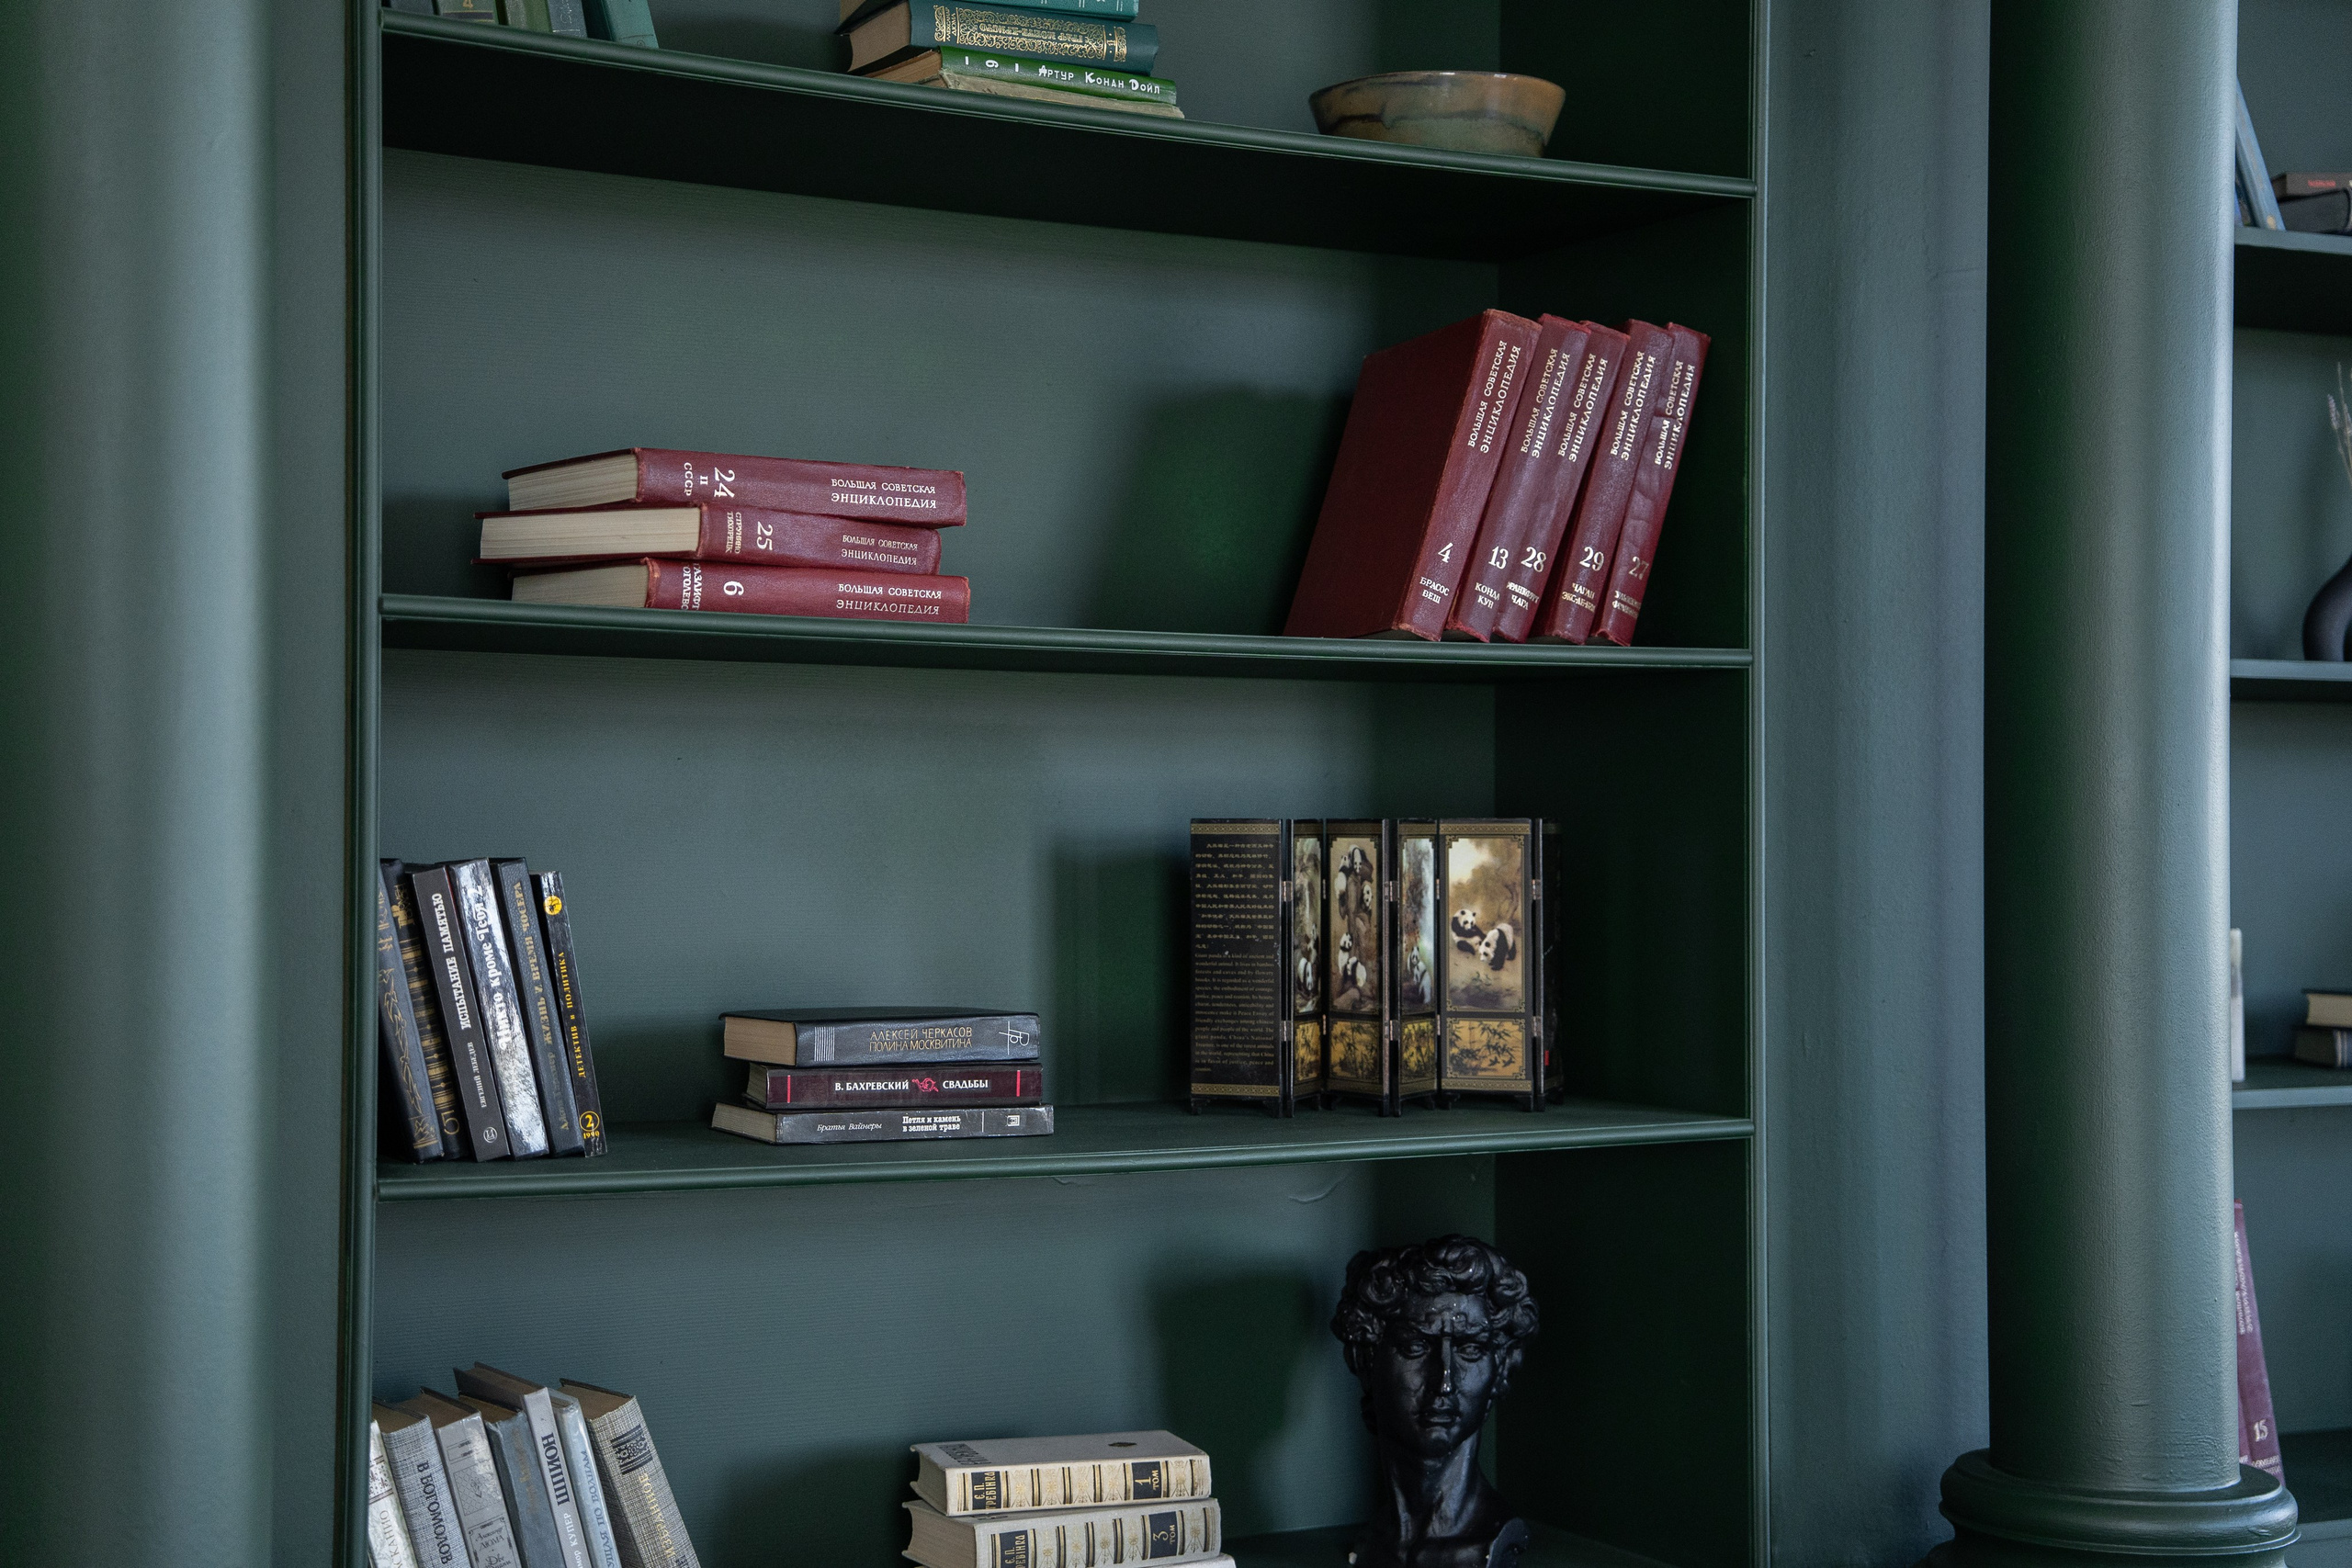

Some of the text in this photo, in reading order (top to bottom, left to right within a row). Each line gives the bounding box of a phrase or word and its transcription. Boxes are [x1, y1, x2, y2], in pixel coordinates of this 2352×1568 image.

[1467, 339, 1508, 448] БОЛЬШАЯ СОВЕТСКАЯ
[1479, 344, 1522, 455] ЭНЦИКЛОПЕДИЯ
[1665, 359, 1684, 416] СОВЕТСКАЯ
[1521, 348, 1558, 454] БОЛЬШАЯ СОВЕТСКАЯ
[1532, 352, 1570, 458] ЭНЦИКЛОПЕДИЯ
[1558, 353, 1597, 457] БОЛЬШАЯ СОВЕТСКАЯ
[1568, 357, 1609, 463] ЭНЦИКЛОПЕДИЯ
[1610, 351, 1645, 457] БОЛЬШАЯ СОВЕТСКАЯ
[1621, 355, 1657, 461] ЭНЦИКЛОПЕДИЯ
[683, 462, 693, 497] СССР
[713, 466, 736, 499] 24
[831, 477, 936, 494] БОЛЬШАЯ СОВЕТСКАЯ
[831, 492, 937, 510] ЭНЦИКЛОПЕДИЯ
[756, 522, 774, 551] 25
[842, 534, 919, 552] БОЛЬШАЯ СОВЕТСКАЯ
[841, 547, 918, 567] ЭНЦИКЛОПЕДИЯ
[1438, 542, 1453, 563] 4
[1488, 546, 1510, 570] 13
[1521, 547, 1547, 573] 28
[1578, 546, 1605, 571] 29
[1628, 556, 1650, 581] 27
[723, 580, 745, 596] 6
[837, 582, 943, 601] БОЛЬШАЯ СОВЕТСКАЯ
[1419, 576, 1450, 596] БРАСОС
[1422, 589, 1442, 604] ВЕШ
[835, 598, 941, 616] ЭНЦИКЛОПЕДИЯ
[1477, 594, 1495, 609] КУН
[1511, 593, 1529, 610] ЧАГА
[513, 881, 530, 931] ЧОСЕРА
[431, 892, 472, 1030] ИСПЫТАНИЕ ПАМЯТЬЮ
[482, 942, 503, 988] кроме
[526, 935, 545, 984] ВРЕМЯ
[559, 952, 574, 1009] ПОЛИТИКА
[869, 1026, 973, 1042] АЛЕКСЕЙ ЧЕРКАСОВ
[869, 1038, 973, 1053] ПОЛИНА МОСКВИТИНА
[571, 1025, 587, 1078] ДЕТЕКТИВ
[834, 1078, 989, 1091] В. БАХРЕВСКИЙ СВАДЬБЫ
[441, 1110, 459, 1134] 5
[817, 1123, 846, 1134] Братья
[902, 1115, 926, 1124] Петля
[2254, 1418, 2269, 1442] 15
[541, 1433, 571, 1506] ШПИОН
[1134, 1477, 1151, 1485] 1
[420, 1472, 452, 1565] БОГОМОЛОВ
[594, 1507, 605, 1527] ПО
[638, 1473, 675, 1560] ИЗБРАННОЕ
[563, 1513, 578, 1547] КУПЕР
[1152, 1530, 1169, 1542] 3
[1014, 1534, 1026, 1568] РЕБІНКА
